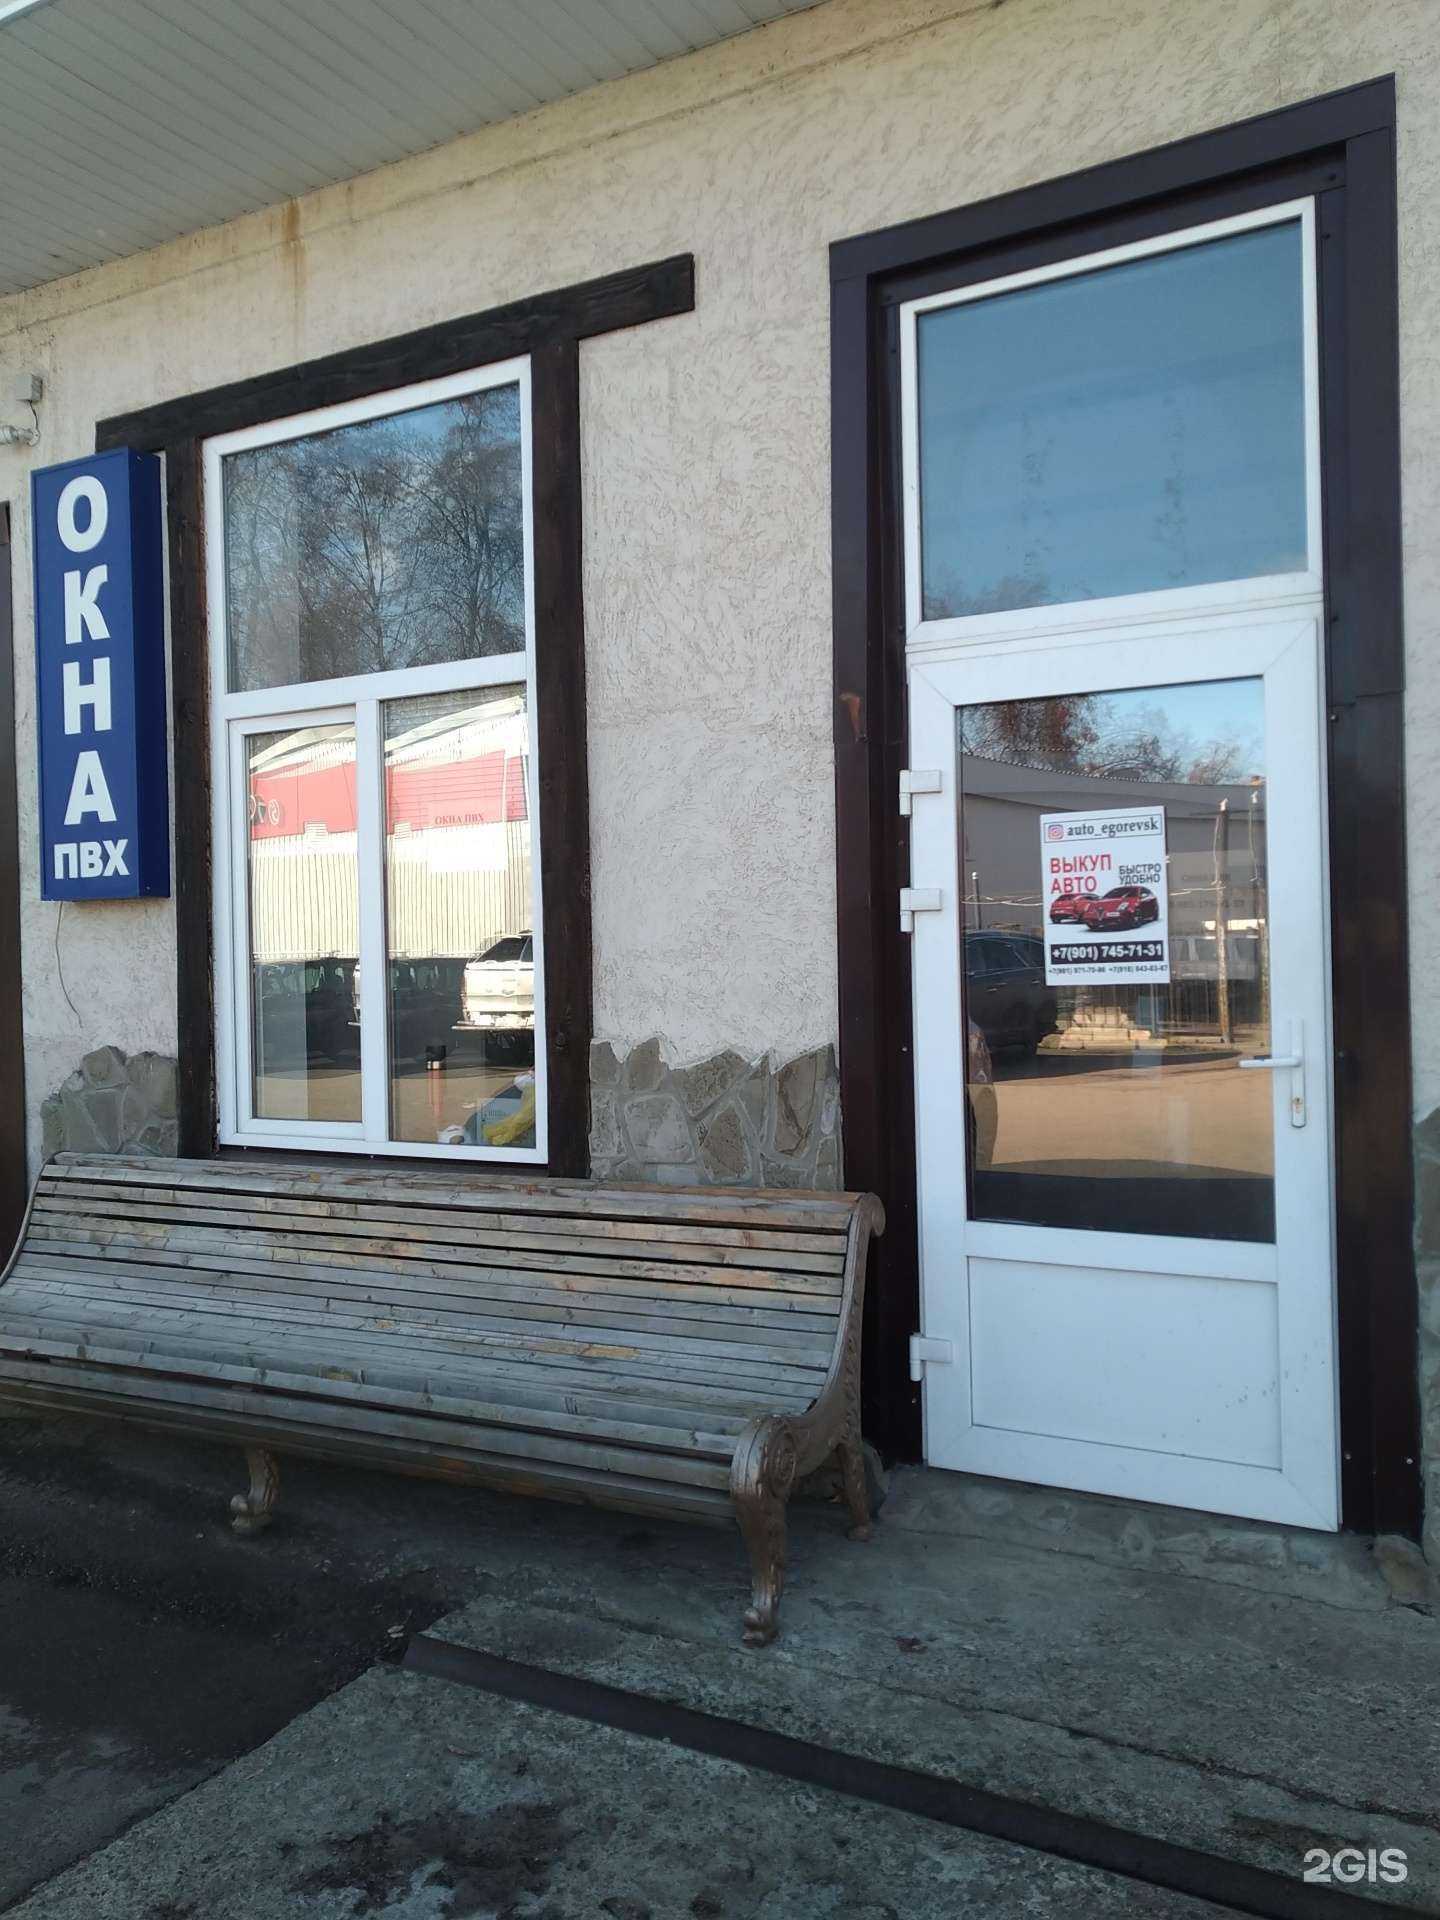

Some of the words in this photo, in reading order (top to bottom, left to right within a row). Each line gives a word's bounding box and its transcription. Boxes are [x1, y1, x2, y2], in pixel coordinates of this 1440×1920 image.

[57, 475, 117, 826] ОКНА
[1067, 817, 1159, 838] auto_egorevsk
[53, 838, 130, 880] ПВХ
[1050, 854, 1112, 874] ВЫКУП
[1119, 863, 1162, 876] БЫСТРО
[1119, 873, 1161, 885] УДОБНО
[1050, 876, 1098, 894] АВТО
[1052, 946, 1099, 961] +7(901)
[1101, 943, 1162, 957] 745-71-31
